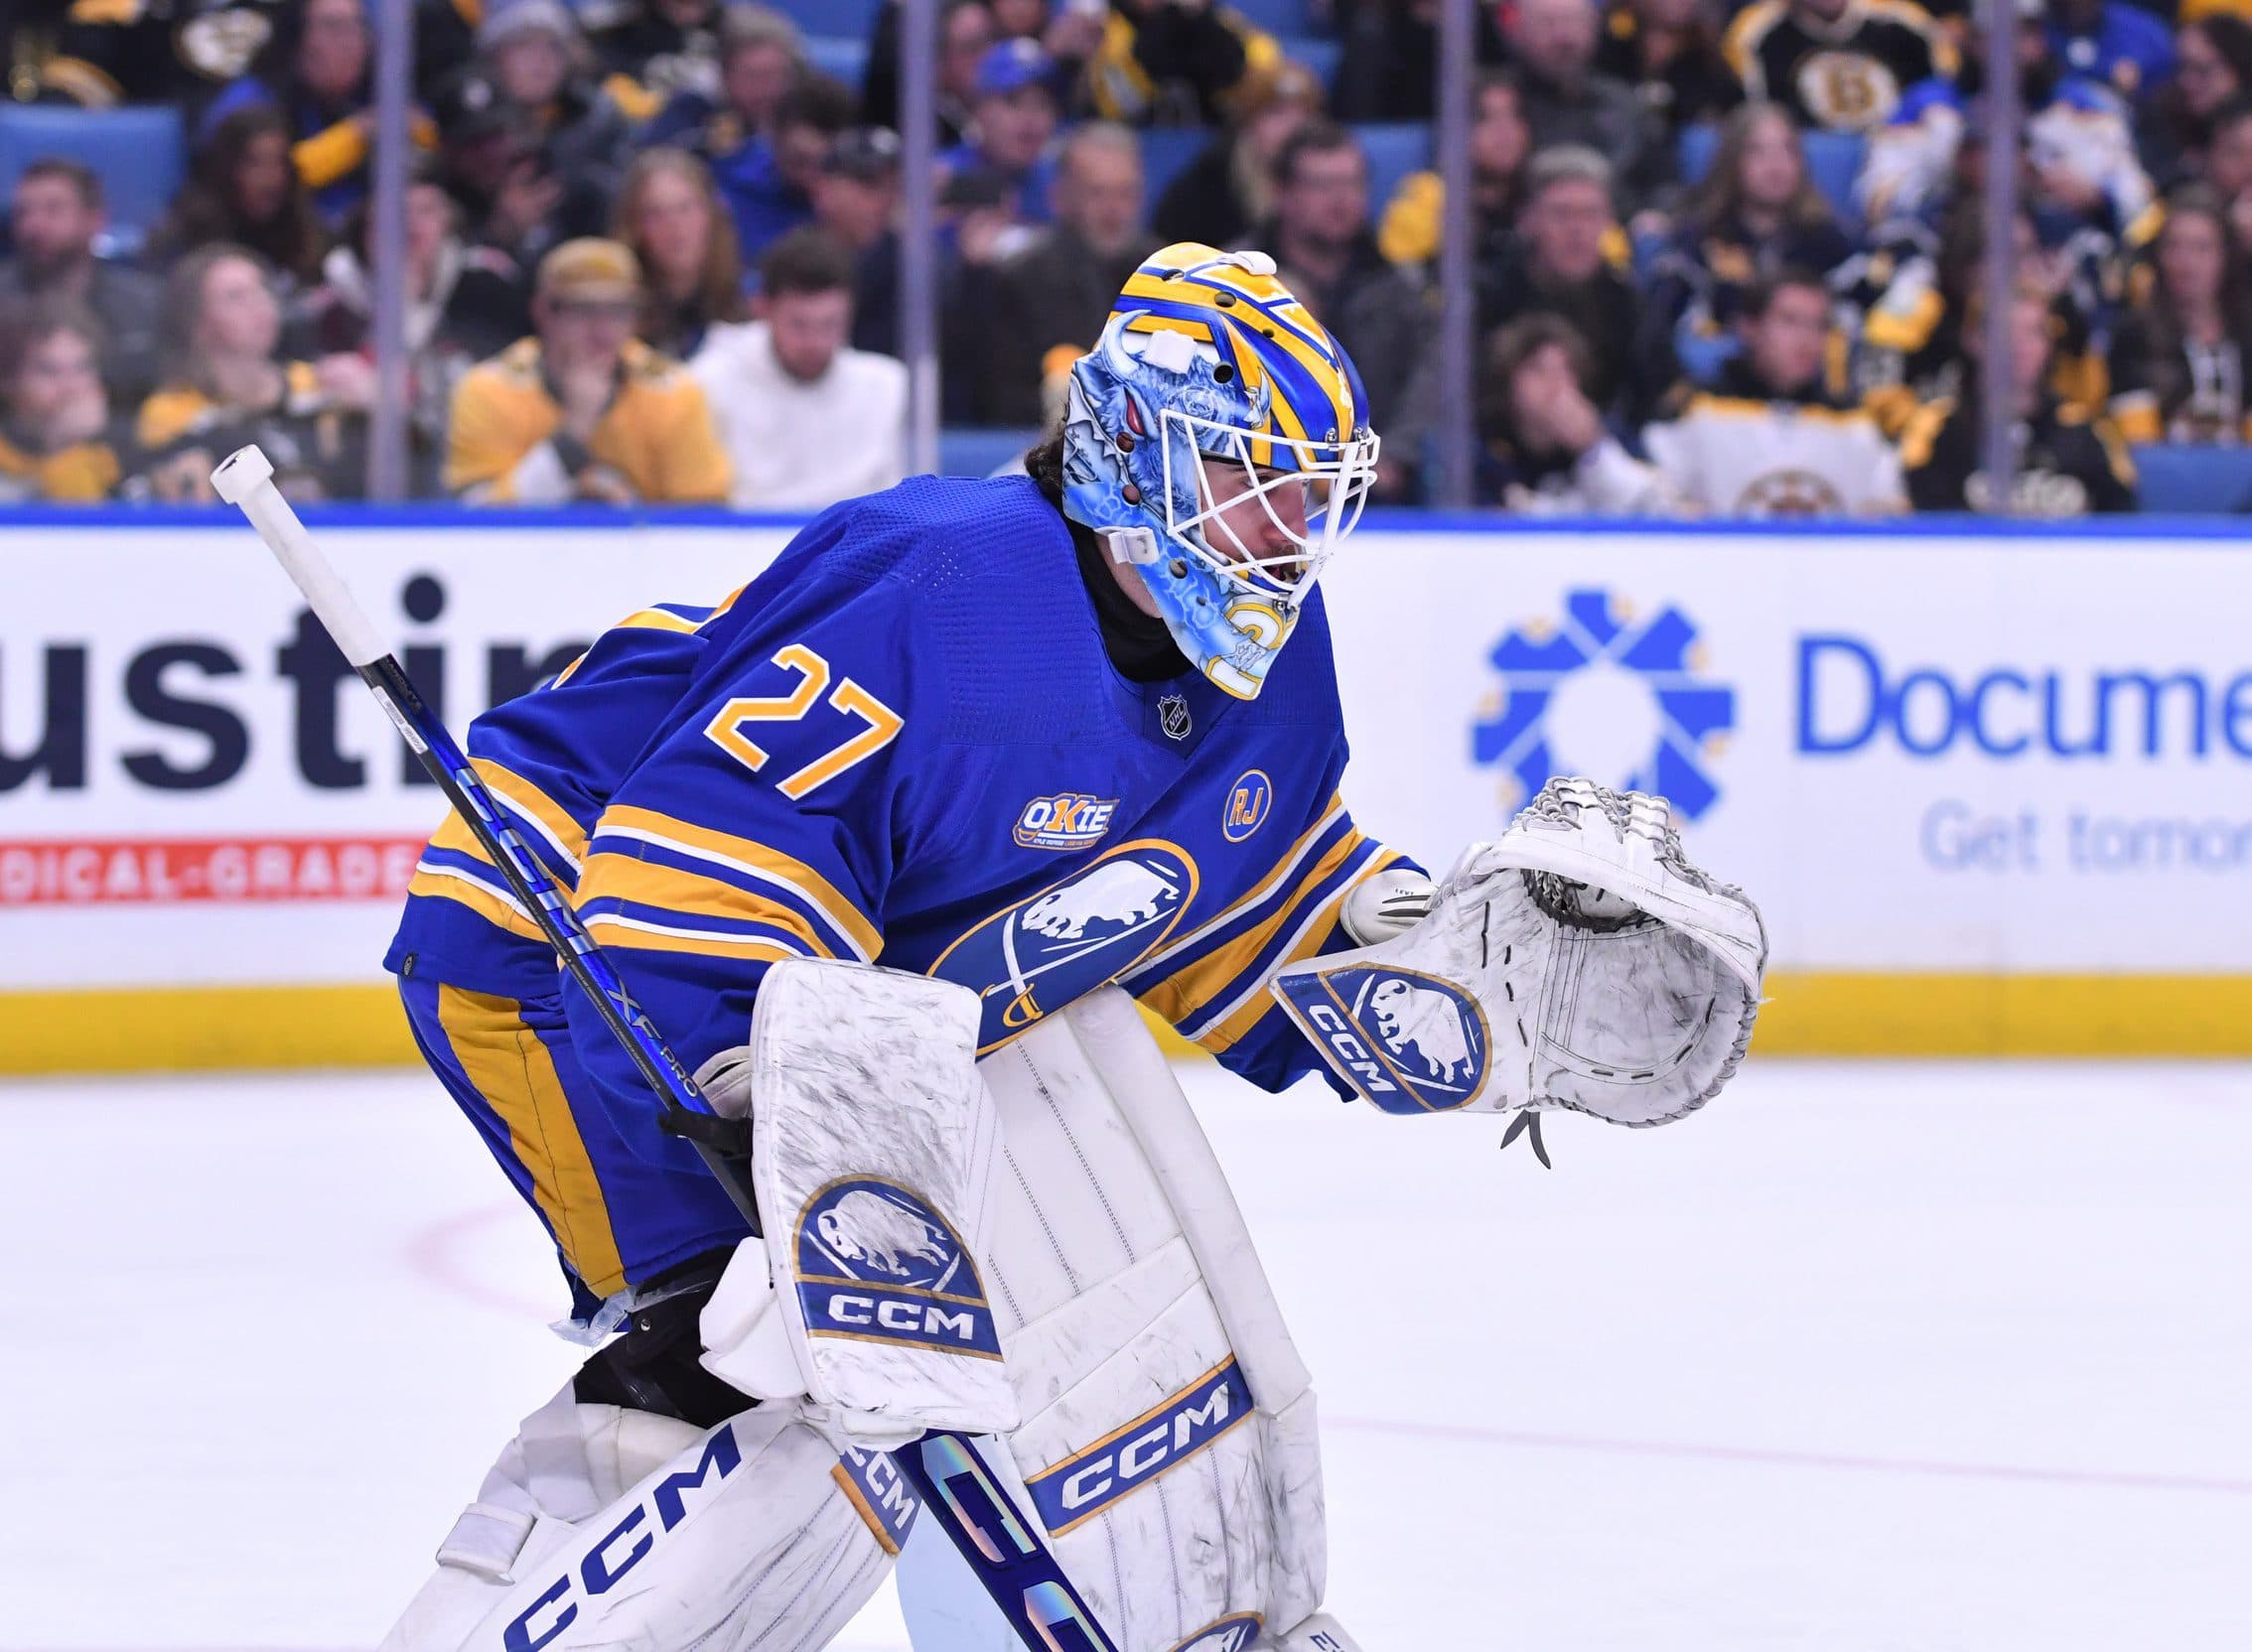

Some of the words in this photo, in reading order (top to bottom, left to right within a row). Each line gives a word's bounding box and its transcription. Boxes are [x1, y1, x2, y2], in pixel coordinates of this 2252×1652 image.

[703, 641, 906, 802] 27
[1227, 786, 1264, 827] RJ
[1920, 798, 2038, 873] Get
[455, 767, 601, 956] CCM
[660, 1045, 698, 1098] PRO
[1308, 1004, 1398, 1093] CCM
[828, 1294, 975, 1341] CCM
[1061, 1380, 1229, 1512] CCM
[502, 1422, 742, 1652] CCM
